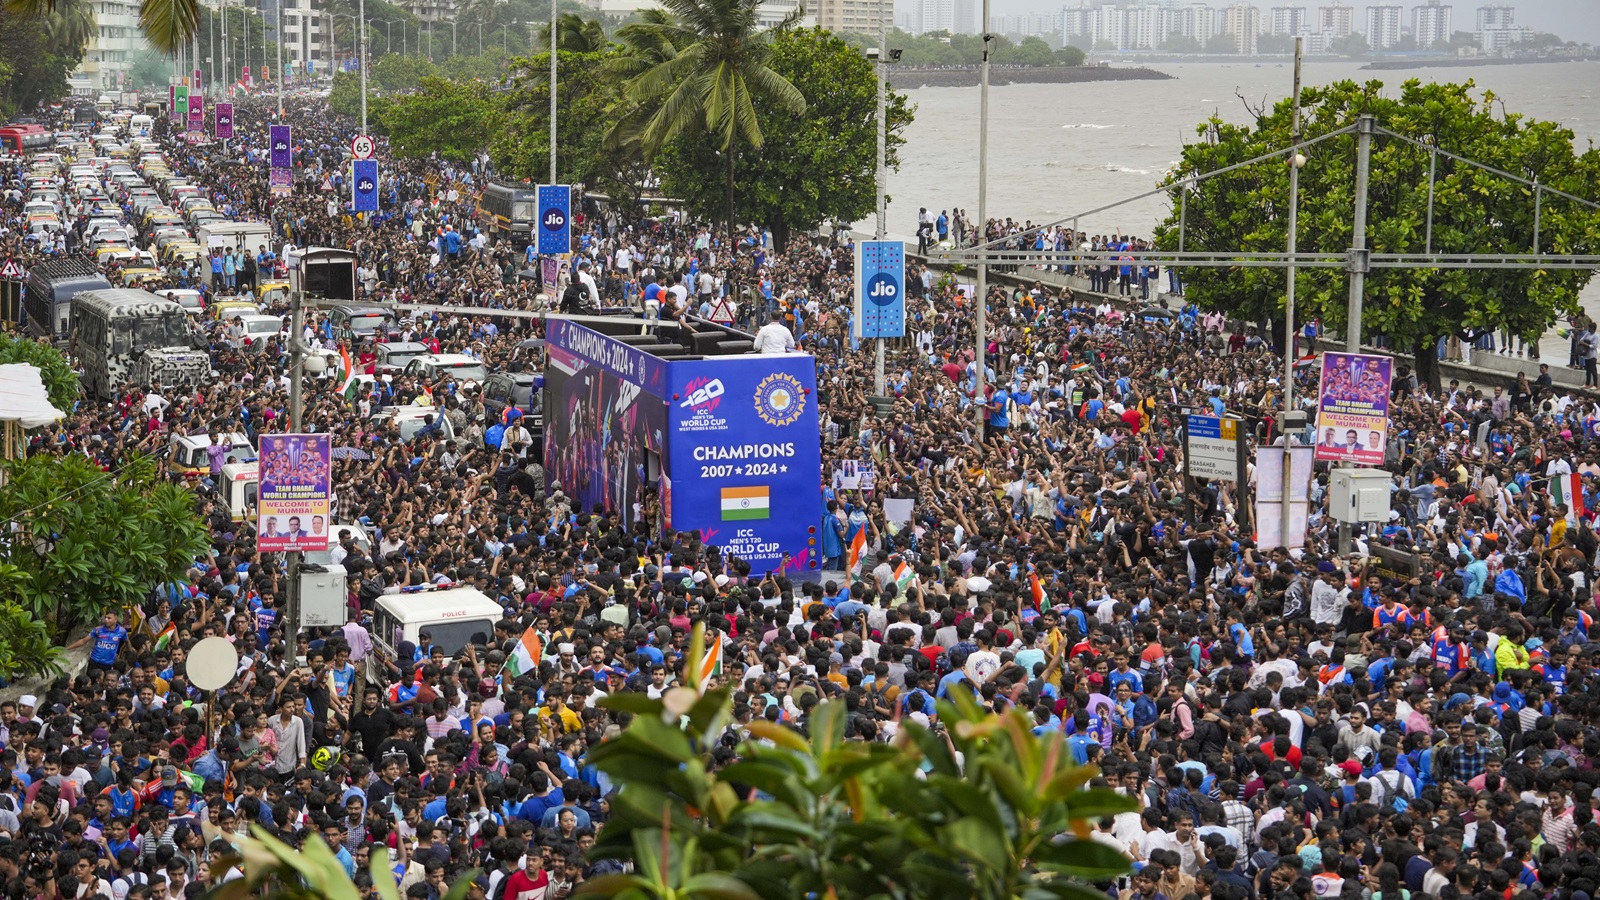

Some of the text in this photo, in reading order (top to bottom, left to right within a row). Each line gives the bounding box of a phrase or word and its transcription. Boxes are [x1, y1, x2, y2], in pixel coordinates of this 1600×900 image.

[274, 142, 287, 150] Jio
[356, 142, 370, 152] 65
[358, 181, 373, 190] Jio
[545, 214, 564, 225] Jio
[871, 280, 895, 296] Jio
[568, 324, 629, 375] CHAMPIONS 2024
[1347, 407, 1384, 416] CHAMPIONS
[1326, 414, 1368, 422] WELCOME
[693, 442, 795, 461] CHAMPIONS
[701, 463, 777, 478] 2007 2024
[737, 529, 754, 537] ICC
[757, 543, 780, 552] CUP
[97, 641, 116, 650] slice
